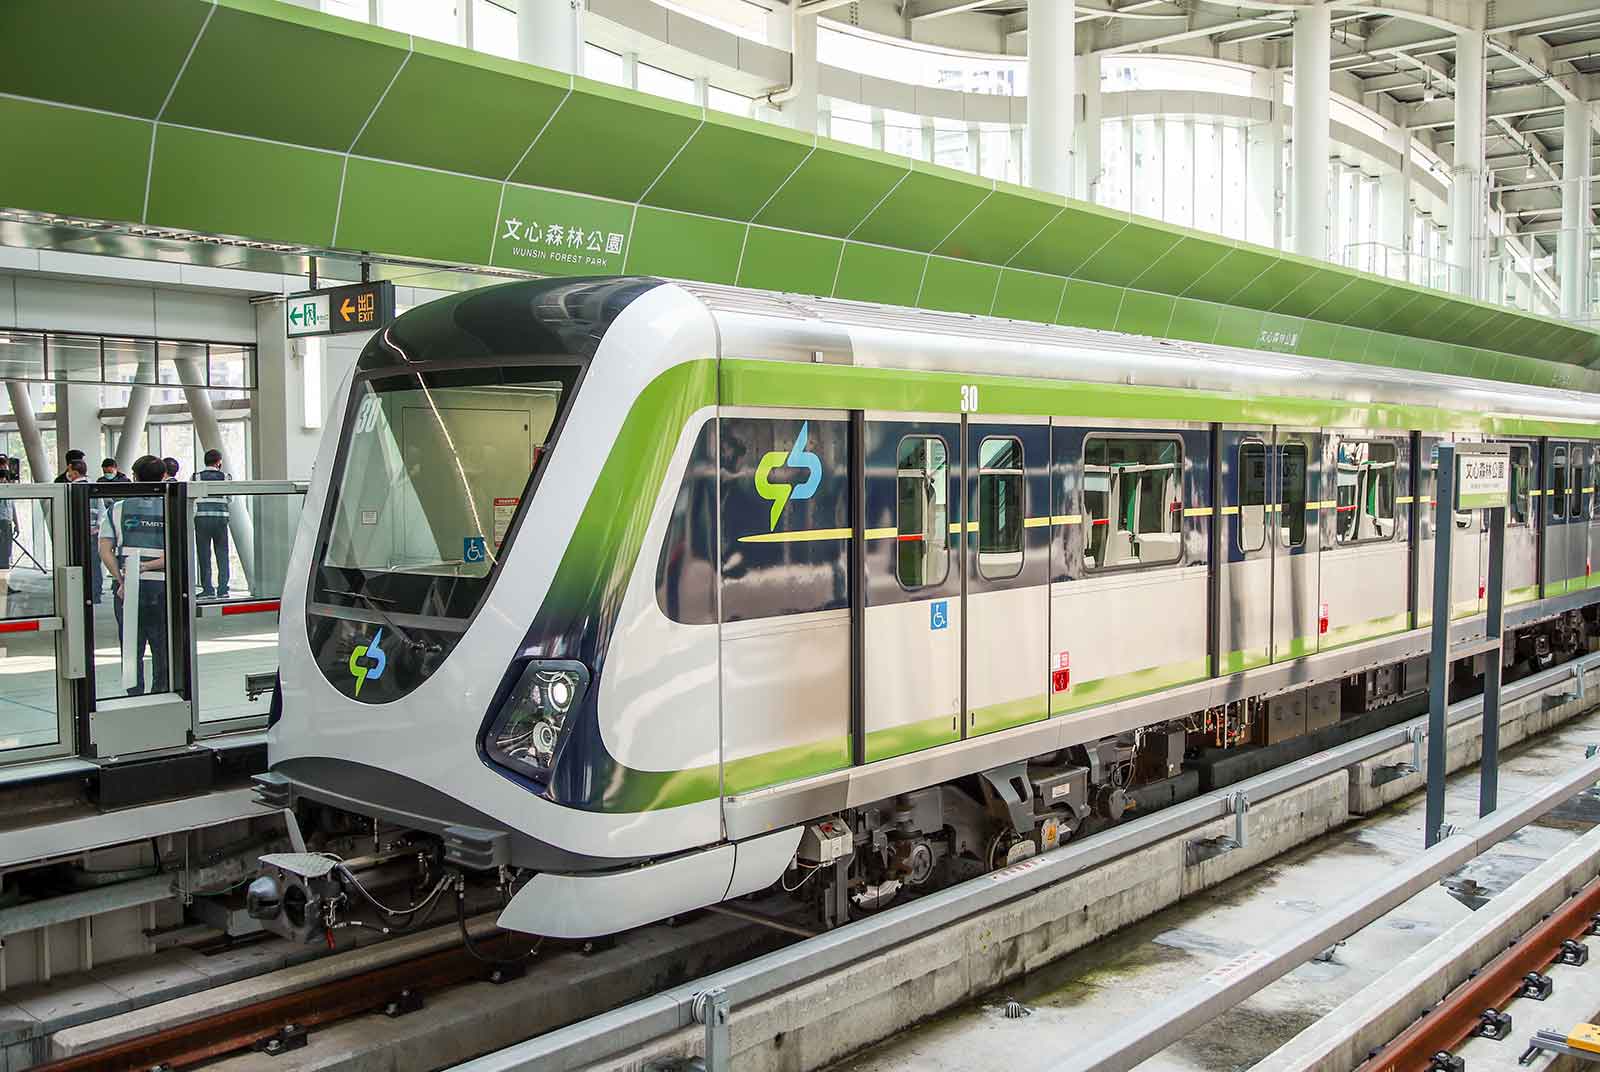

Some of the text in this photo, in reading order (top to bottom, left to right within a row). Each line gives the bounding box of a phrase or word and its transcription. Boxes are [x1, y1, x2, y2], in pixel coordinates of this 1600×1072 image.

[502, 217, 624, 255] 文心森林公園
[512, 247, 608, 266] WUNSIN FOREST PARK
[357, 293, 374, 311] 出口
[358, 311, 374, 322] EXIT
[961, 384, 978, 412] 30
[355, 393, 382, 433] 30
[1465, 461, 1504, 479] 文心森林公園
